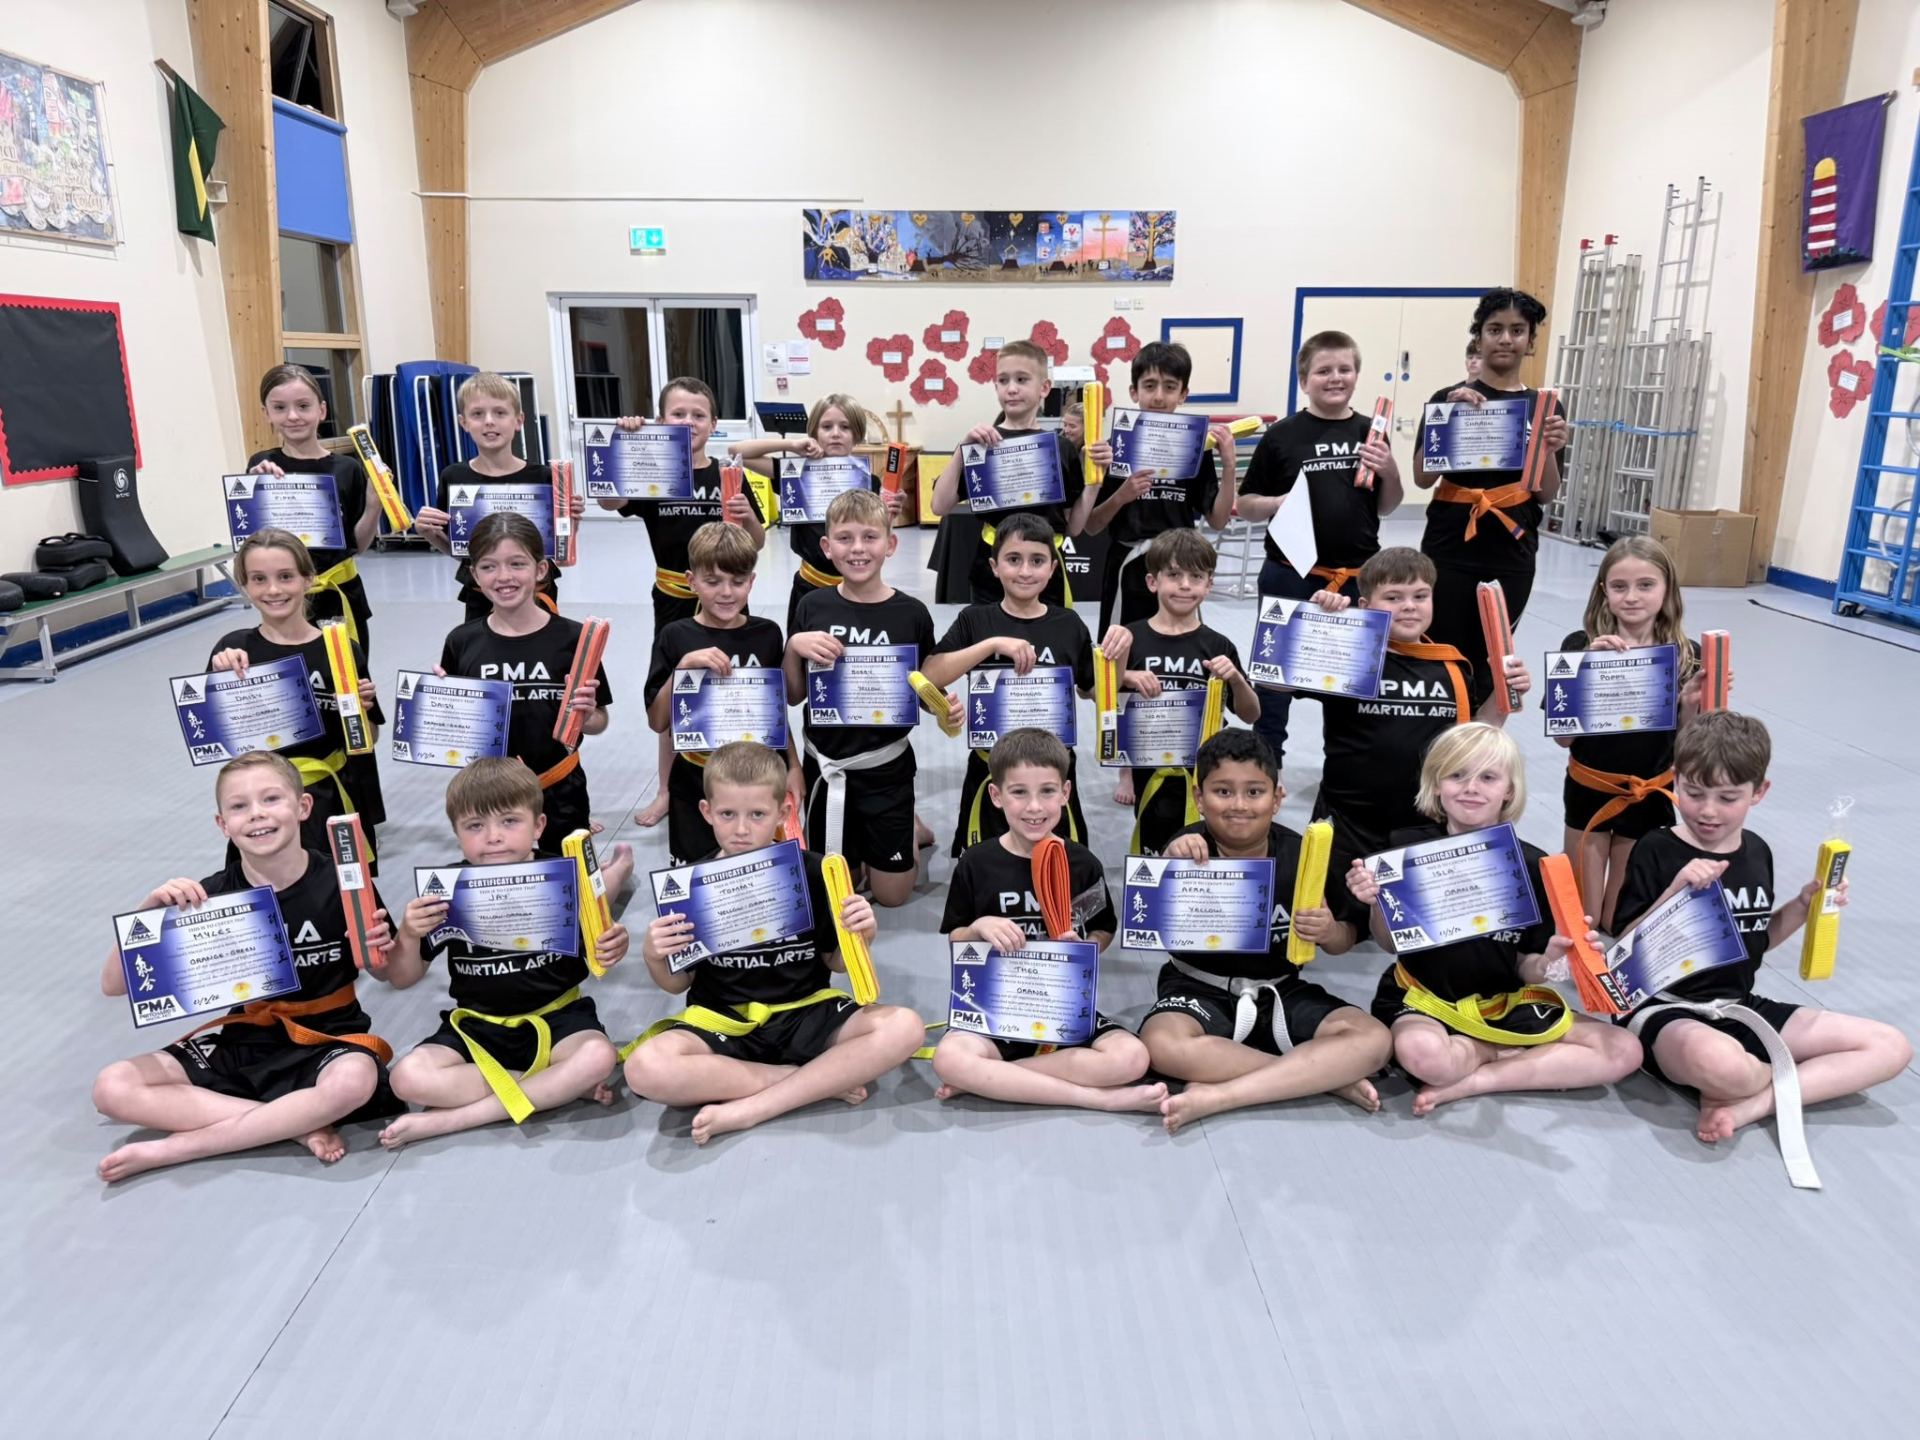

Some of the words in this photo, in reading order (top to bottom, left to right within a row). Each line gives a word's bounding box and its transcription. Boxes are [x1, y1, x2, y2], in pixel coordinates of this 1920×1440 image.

[888, 449, 898, 472] BLITZ
[1112, 462, 1129, 472] PMA
[1303, 461, 1350, 473] MARTIAL
[590, 482, 613, 491] PMA
[972, 496, 993, 505] PMA
[1160, 491, 1186, 502] ARTS
[659, 507, 705, 516] MARTIAL
[784, 509, 803, 517] PMA
[453, 542, 469, 550] PM
[829, 625, 891, 646] PMA
[730, 653, 762, 668] MA
[1145, 656, 1204, 676] PMA
[481, 661, 551, 681] PMA
[1252, 663, 1279, 676] PMA
[528, 689, 564, 700] ARTS
[1380, 679, 1449, 699] PMA
[812, 709, 837, 718] PMA
[1358, 702, 1420, 717] MARTIAL
[1549, 718, 1577, 728] PMA
[348, 717, 362, 745] BLITZ
[676, 733, 702, 742] PMA
[971, 732, 996, 741] PMA
[193, 744, 223, 757] PMA
[393, 741, 408, 752] PMA
[1104, 730, 1113, 760] BLITZ
[337, 828, 354, 863] BLITZ
[1415, 851, 1456, 865] CERTIFICATE
[1467, 843, 1487, 854] RANK
[702, 869, 744, 884] CERTIFICATE
[755, 860, 773, 870] RANK
[1174, 871, 1215, 879] CERTIFICATE
[1216, 871, 1224, 879] OF
[1226, 871, 1244, 879] RANK
[1829, 854, 1846, 888] BLITZ
[469, 877, 515, 888] CERTIFICATE
[515, 875, 524, 883] OF
[526, 874, 546, 883] RANK
[721, 882, 754, 895] TOMMY
[999, 892, 1041, 913] PM
[1728, 886, 1770, 909] MA
[176, 908, 224, 927] CERTIFICATE
[225, 906, 233, 916] OF
[235, 904, 252, 915] RANK
[193, 928, 232, 941] MYLES
[433, 927, 466, 942] PMA
[1126, 930, 1157, 941] PMA
[1394, 926, 1423, 942] PMA
[295, 947, 342, 967] ARTS
[672, 943, 702, 962] PMA
[774, 948, 816, 967] ARTS
[1051, 953, 1069, 962] RANK
[455, 960, 521, 976] MARTIAL
[1014, 966, 1038, 975] THEO
[1601, 974, 1626, 1010] BLITZ
[137, 997, 175, 1015] PMA
[953, 1011, 983, 1025] PMA
